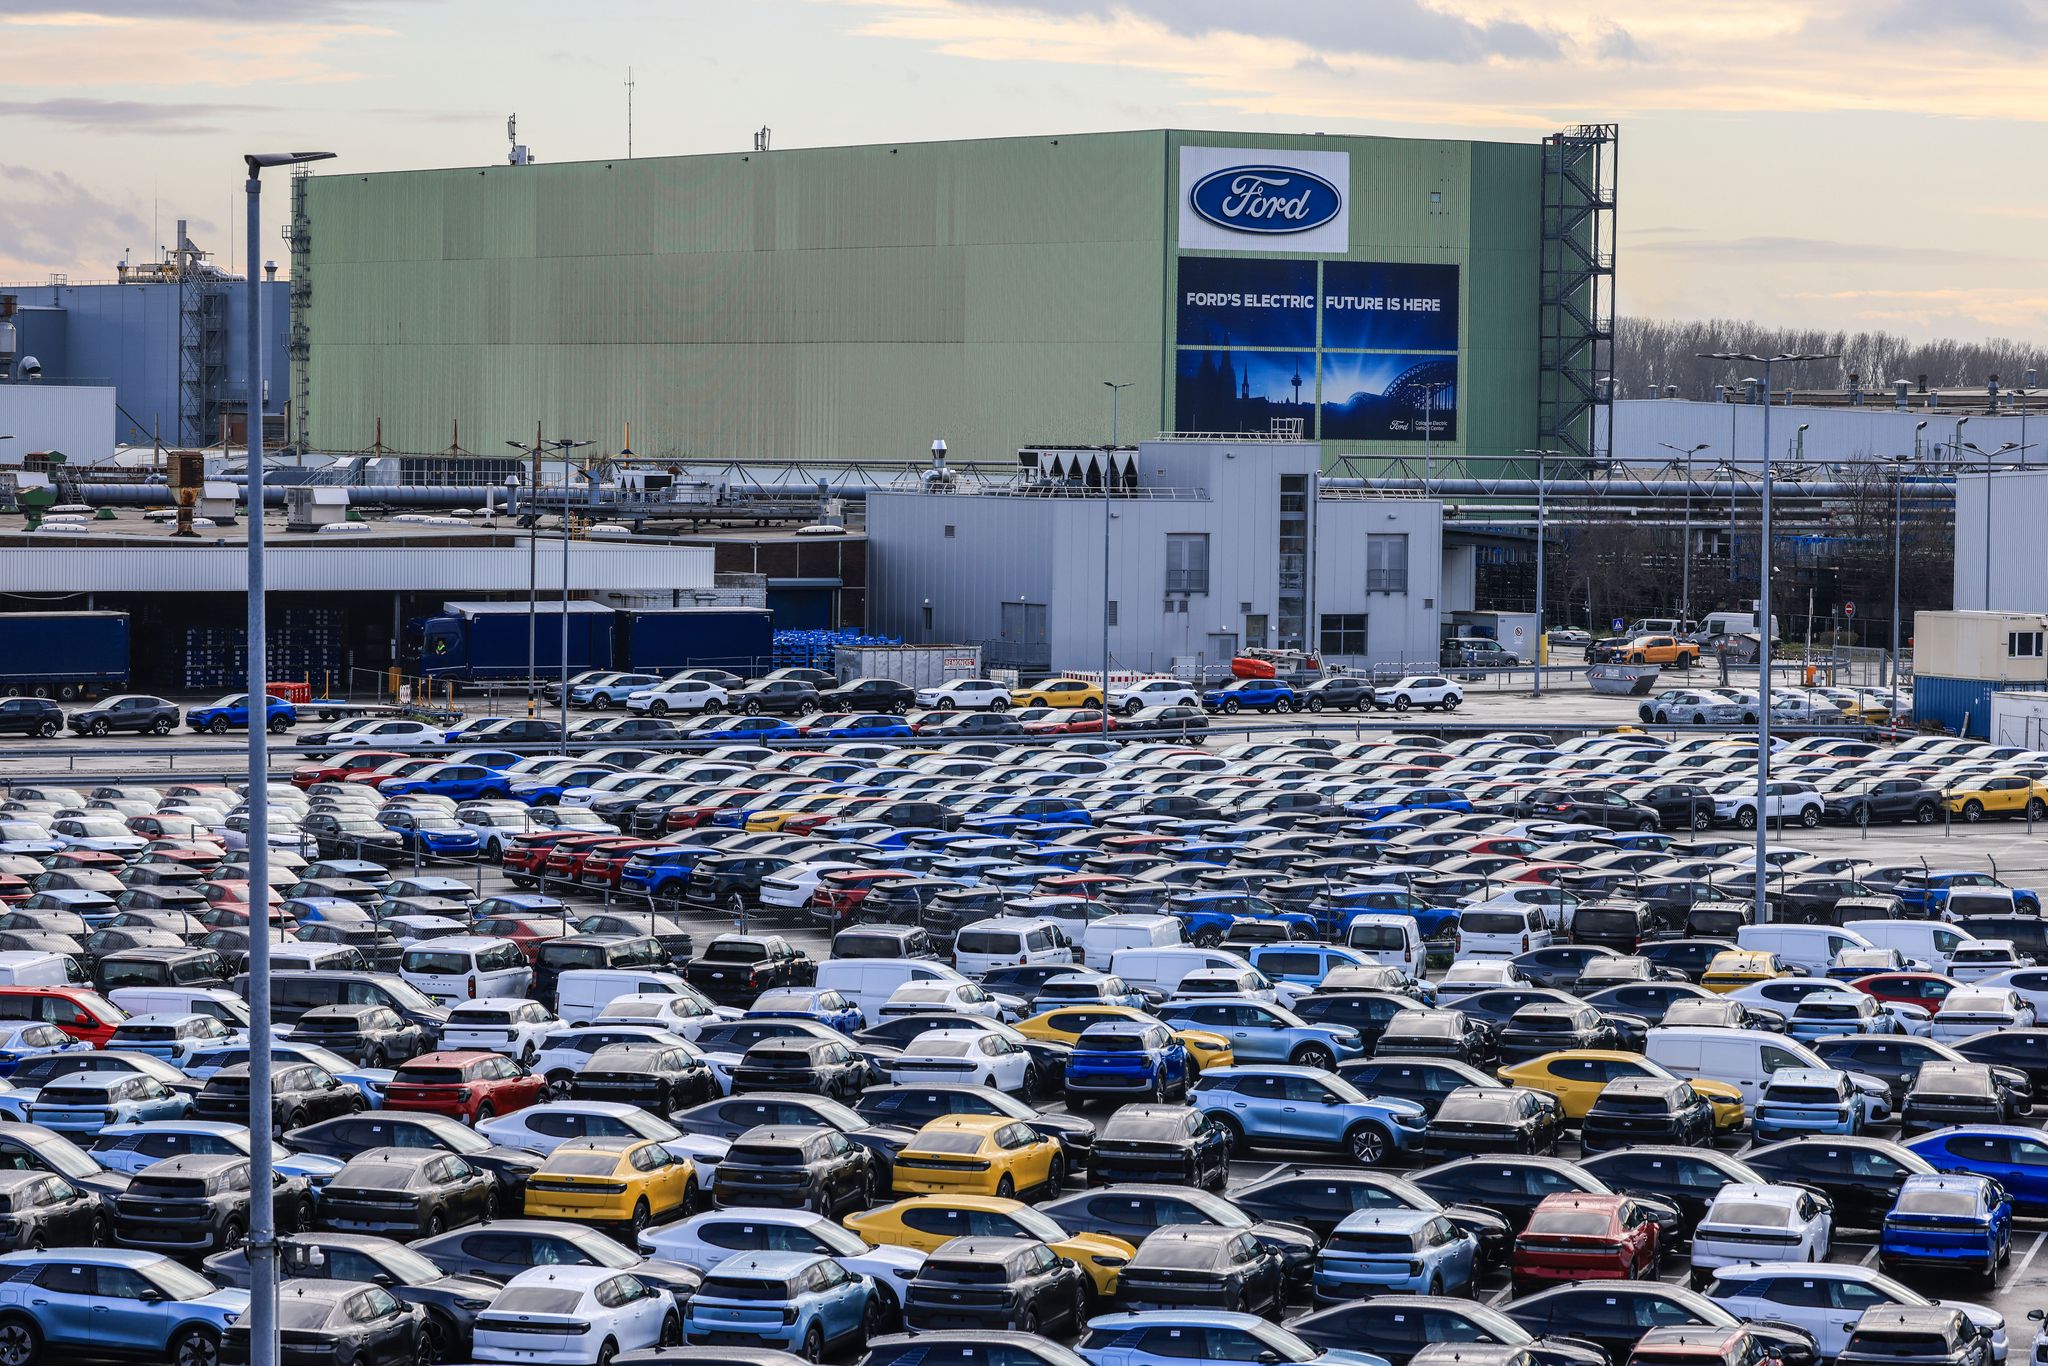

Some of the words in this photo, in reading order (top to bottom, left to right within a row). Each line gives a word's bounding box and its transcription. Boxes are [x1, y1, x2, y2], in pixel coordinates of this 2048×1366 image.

[1221, 174, 1312, 220] Ford
[1186, 292, 1241, 307] FORD'S
[1244, 294, 1314, 309] ELECTRIC
[1325, 296, 1383, 311] FUTURE
[1386, 297, 1400, 311] IS
[1403, 298, 1441, 312] HERE
[1389, 420, 1409, 431] Ford
